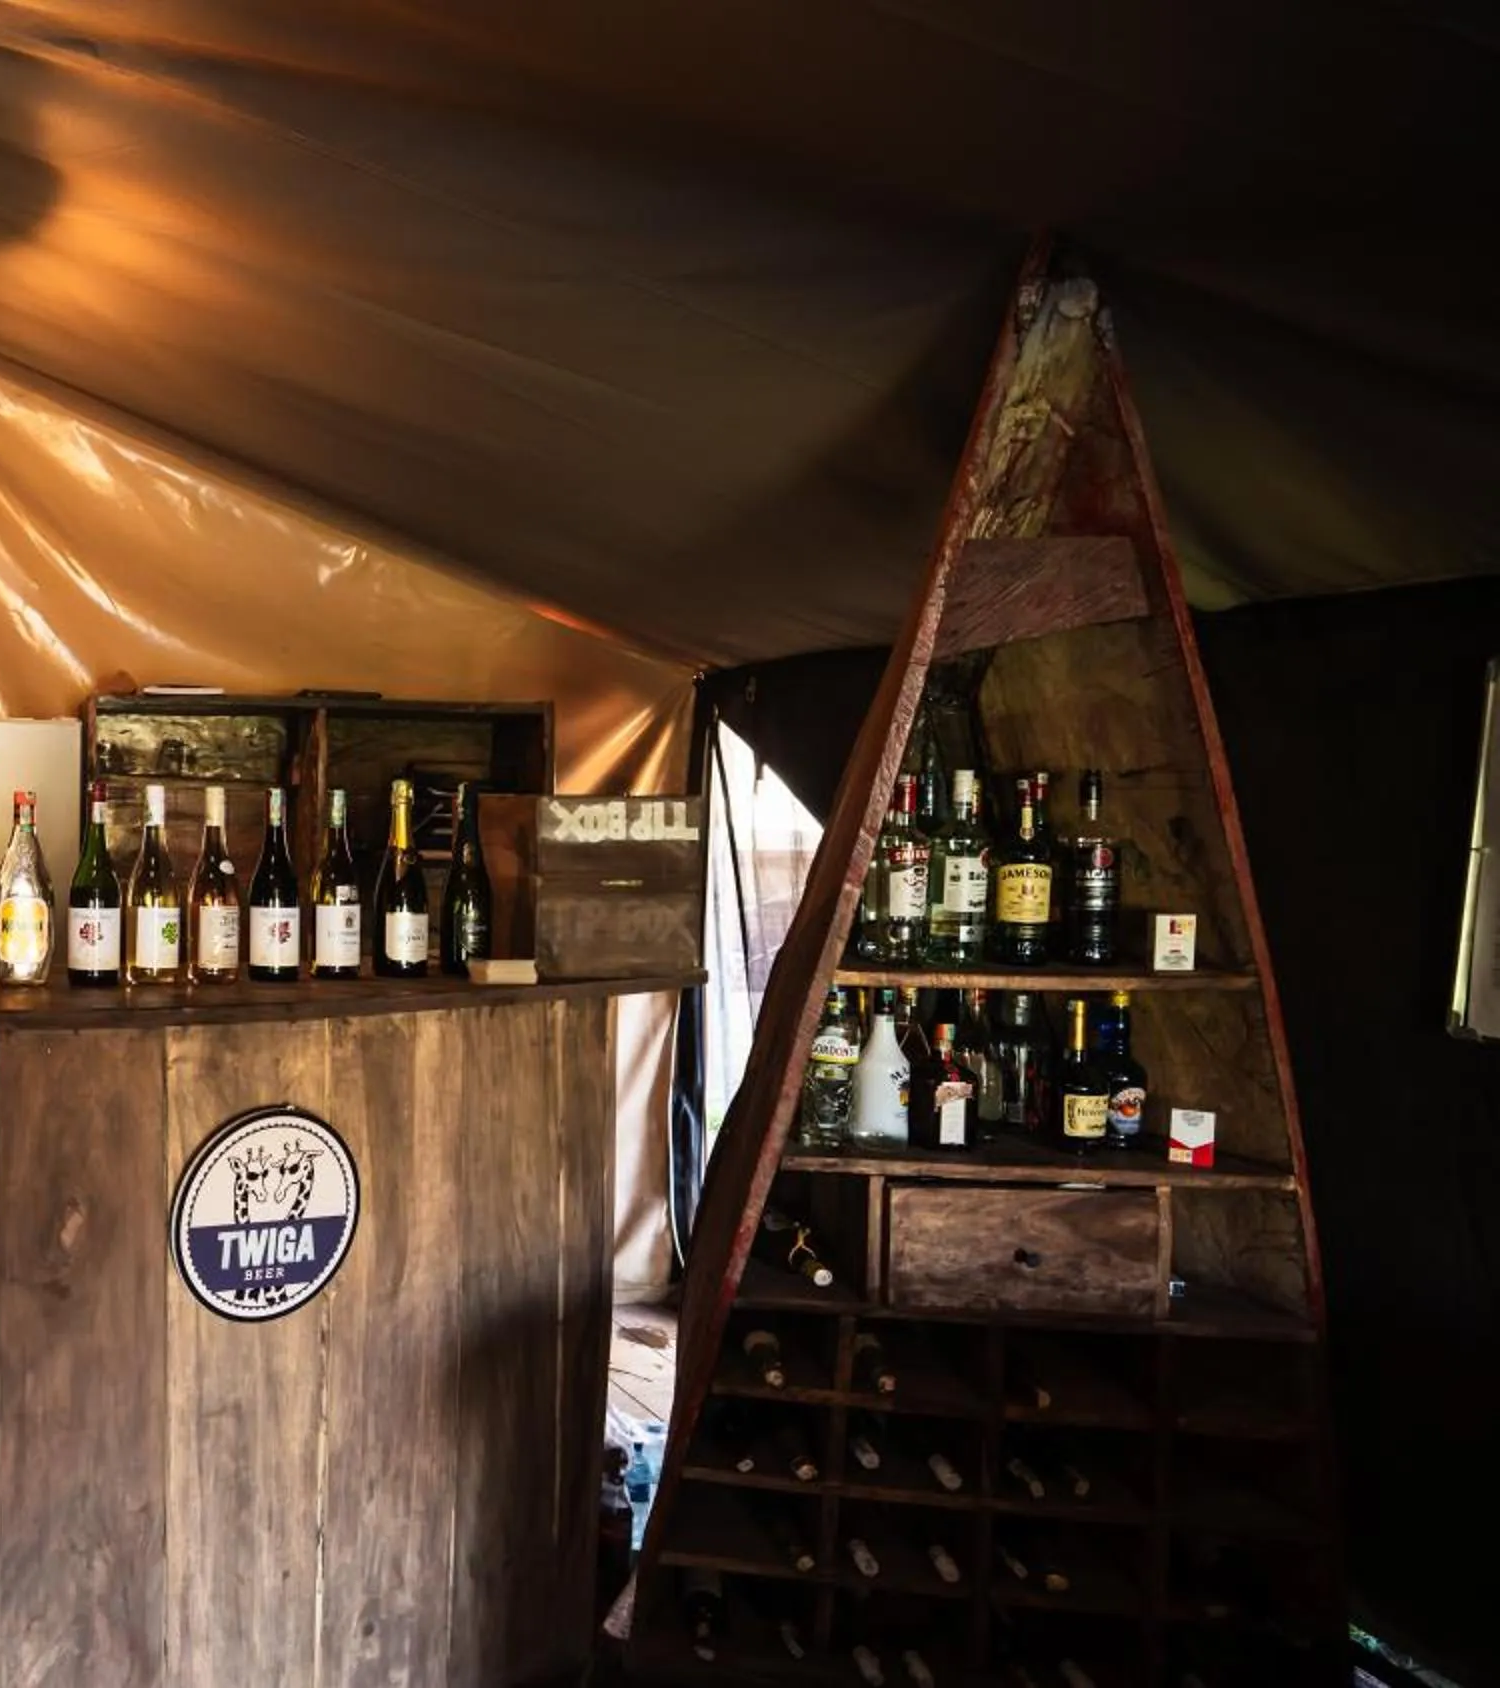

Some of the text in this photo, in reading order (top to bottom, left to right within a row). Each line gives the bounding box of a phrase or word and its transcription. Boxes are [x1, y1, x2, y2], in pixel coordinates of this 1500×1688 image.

[549, 800, 699, 843] TIP BOX
[217, 1224, 316, 1270] TWIGA
[244, 1268, 285, 1281] BEER
